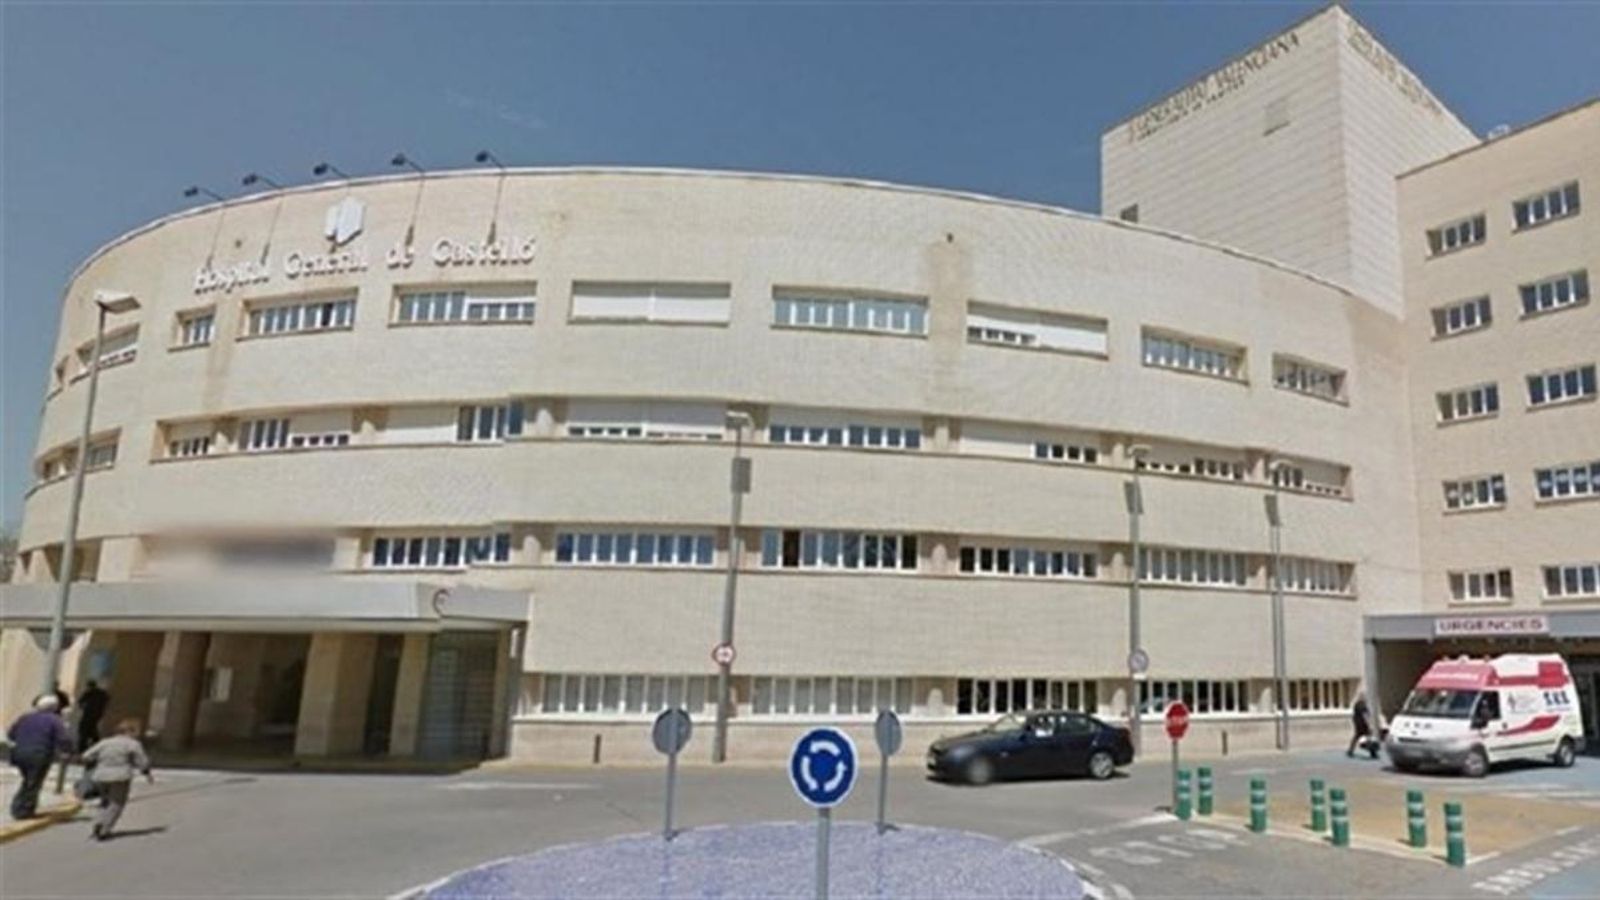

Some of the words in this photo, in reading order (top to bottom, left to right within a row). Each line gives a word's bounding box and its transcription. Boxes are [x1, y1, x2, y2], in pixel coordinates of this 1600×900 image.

[283, 247, 369, 281] General
[386, 242, 415, 270] de
[1438, 617, 1543, 632] URGENCIES
